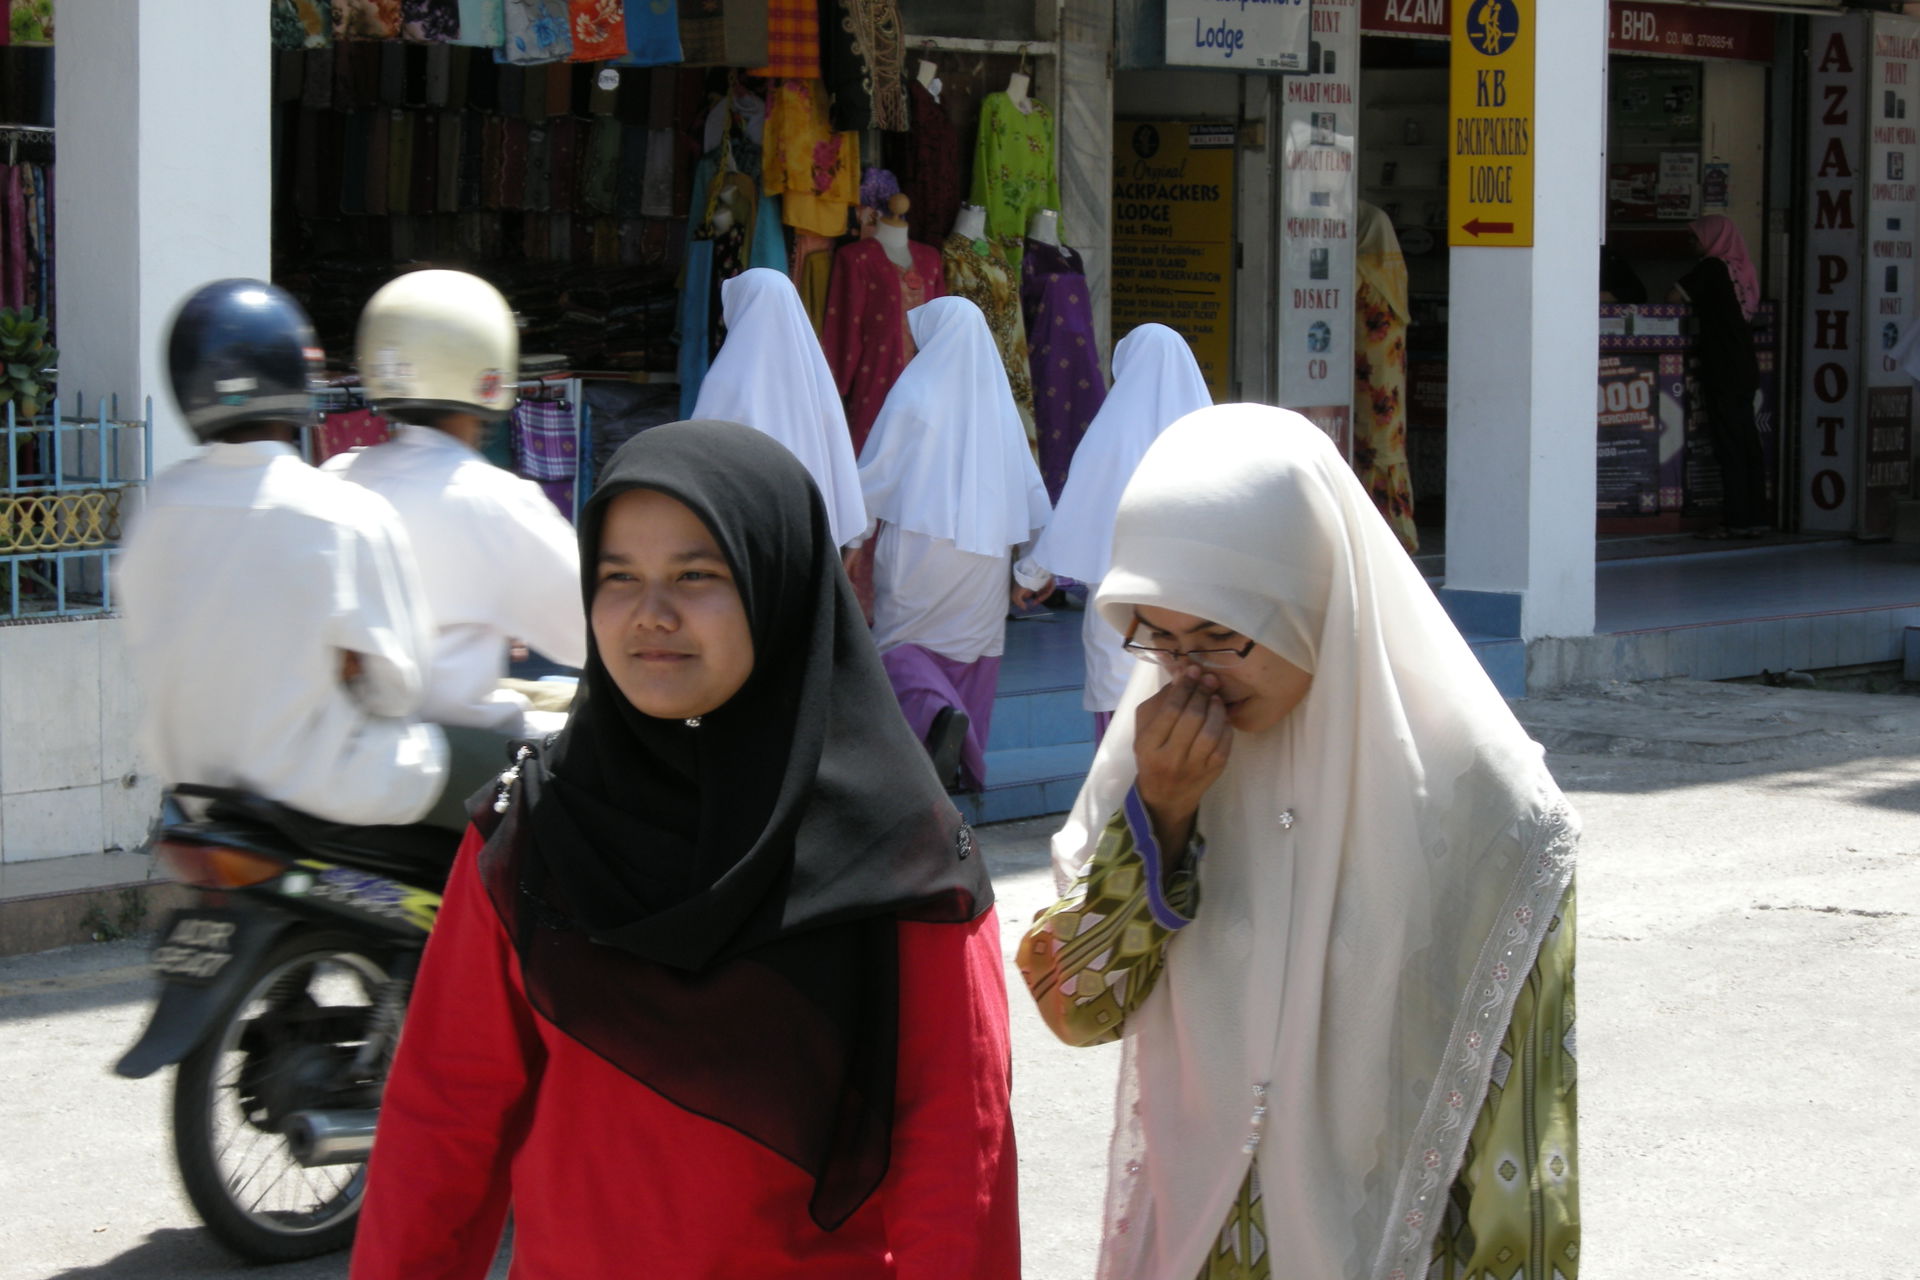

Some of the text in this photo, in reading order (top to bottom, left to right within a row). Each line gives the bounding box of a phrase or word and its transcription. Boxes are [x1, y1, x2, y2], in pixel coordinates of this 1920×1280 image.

[1312, 10, 1341, 33] RINT
[1385, 0, 1443, 25] AZAM
[1195, 17, 1245, 58] Lodge
[1620, 10, 1660, 43] BHD.
[1288, 81, 1352, 104] SMART MEDIA
[1475, 69, 1507, 107] KB
[1456, 117, 1529, 156] BACKPACKERS
[1288, 151, 1353, 172] COMPACT FLASH
[1113, 184, 1221, 202] ACKPACKERS
[1469, 165, 1513, 204] LODGE
[1117, 204, 1170, 222] LODGE
[1322, 218, 1347, 240] STICK
[1810, 32, 1854, 511] AZAM PHOTO
[1294, 289, 1340, 310] DISKET
[1308, 359, 1328, 380] CD
